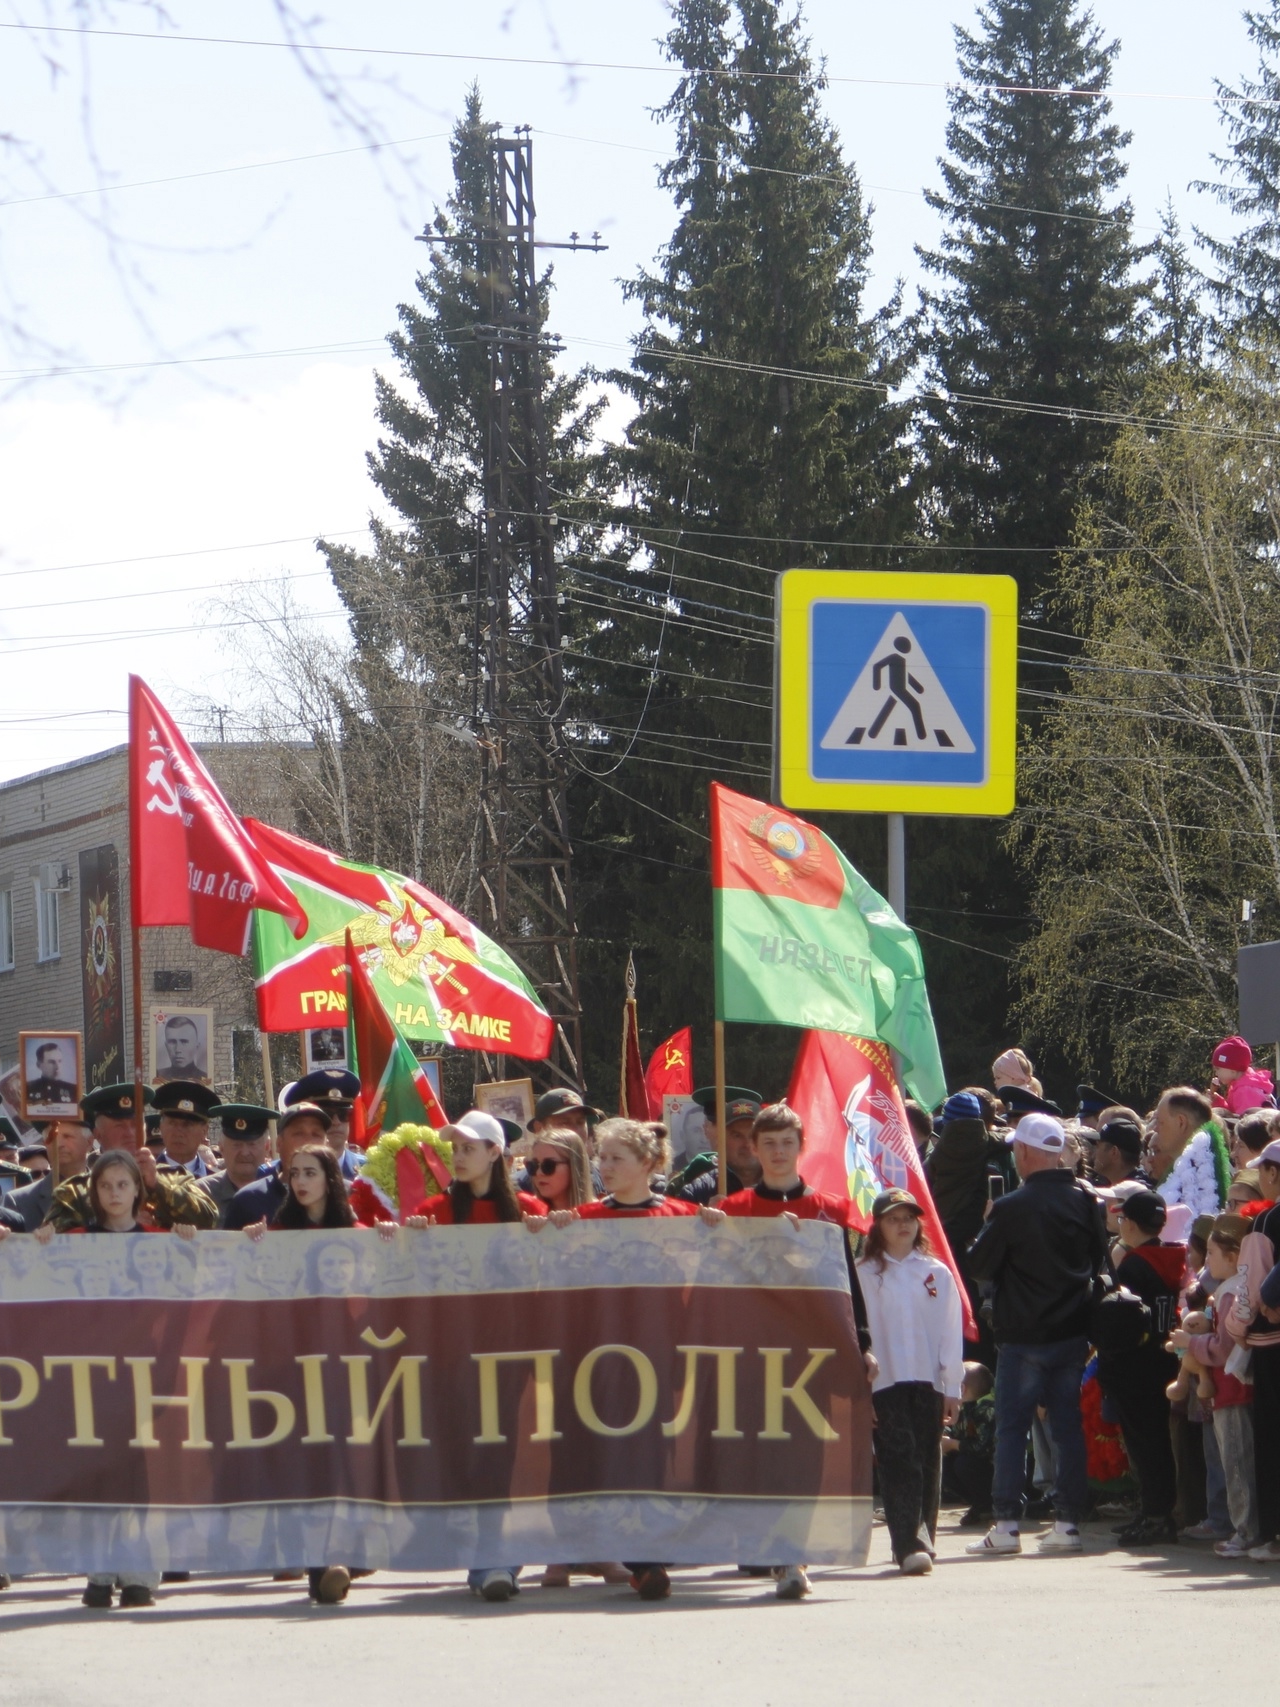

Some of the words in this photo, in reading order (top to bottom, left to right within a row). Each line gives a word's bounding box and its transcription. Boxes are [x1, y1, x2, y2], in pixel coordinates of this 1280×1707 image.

[395, 1002, 430, 1027] НА
[436, 1007, 512, 1043] ЗАМКЕ
[470, 1343, 840, 1445] ПОЛК
